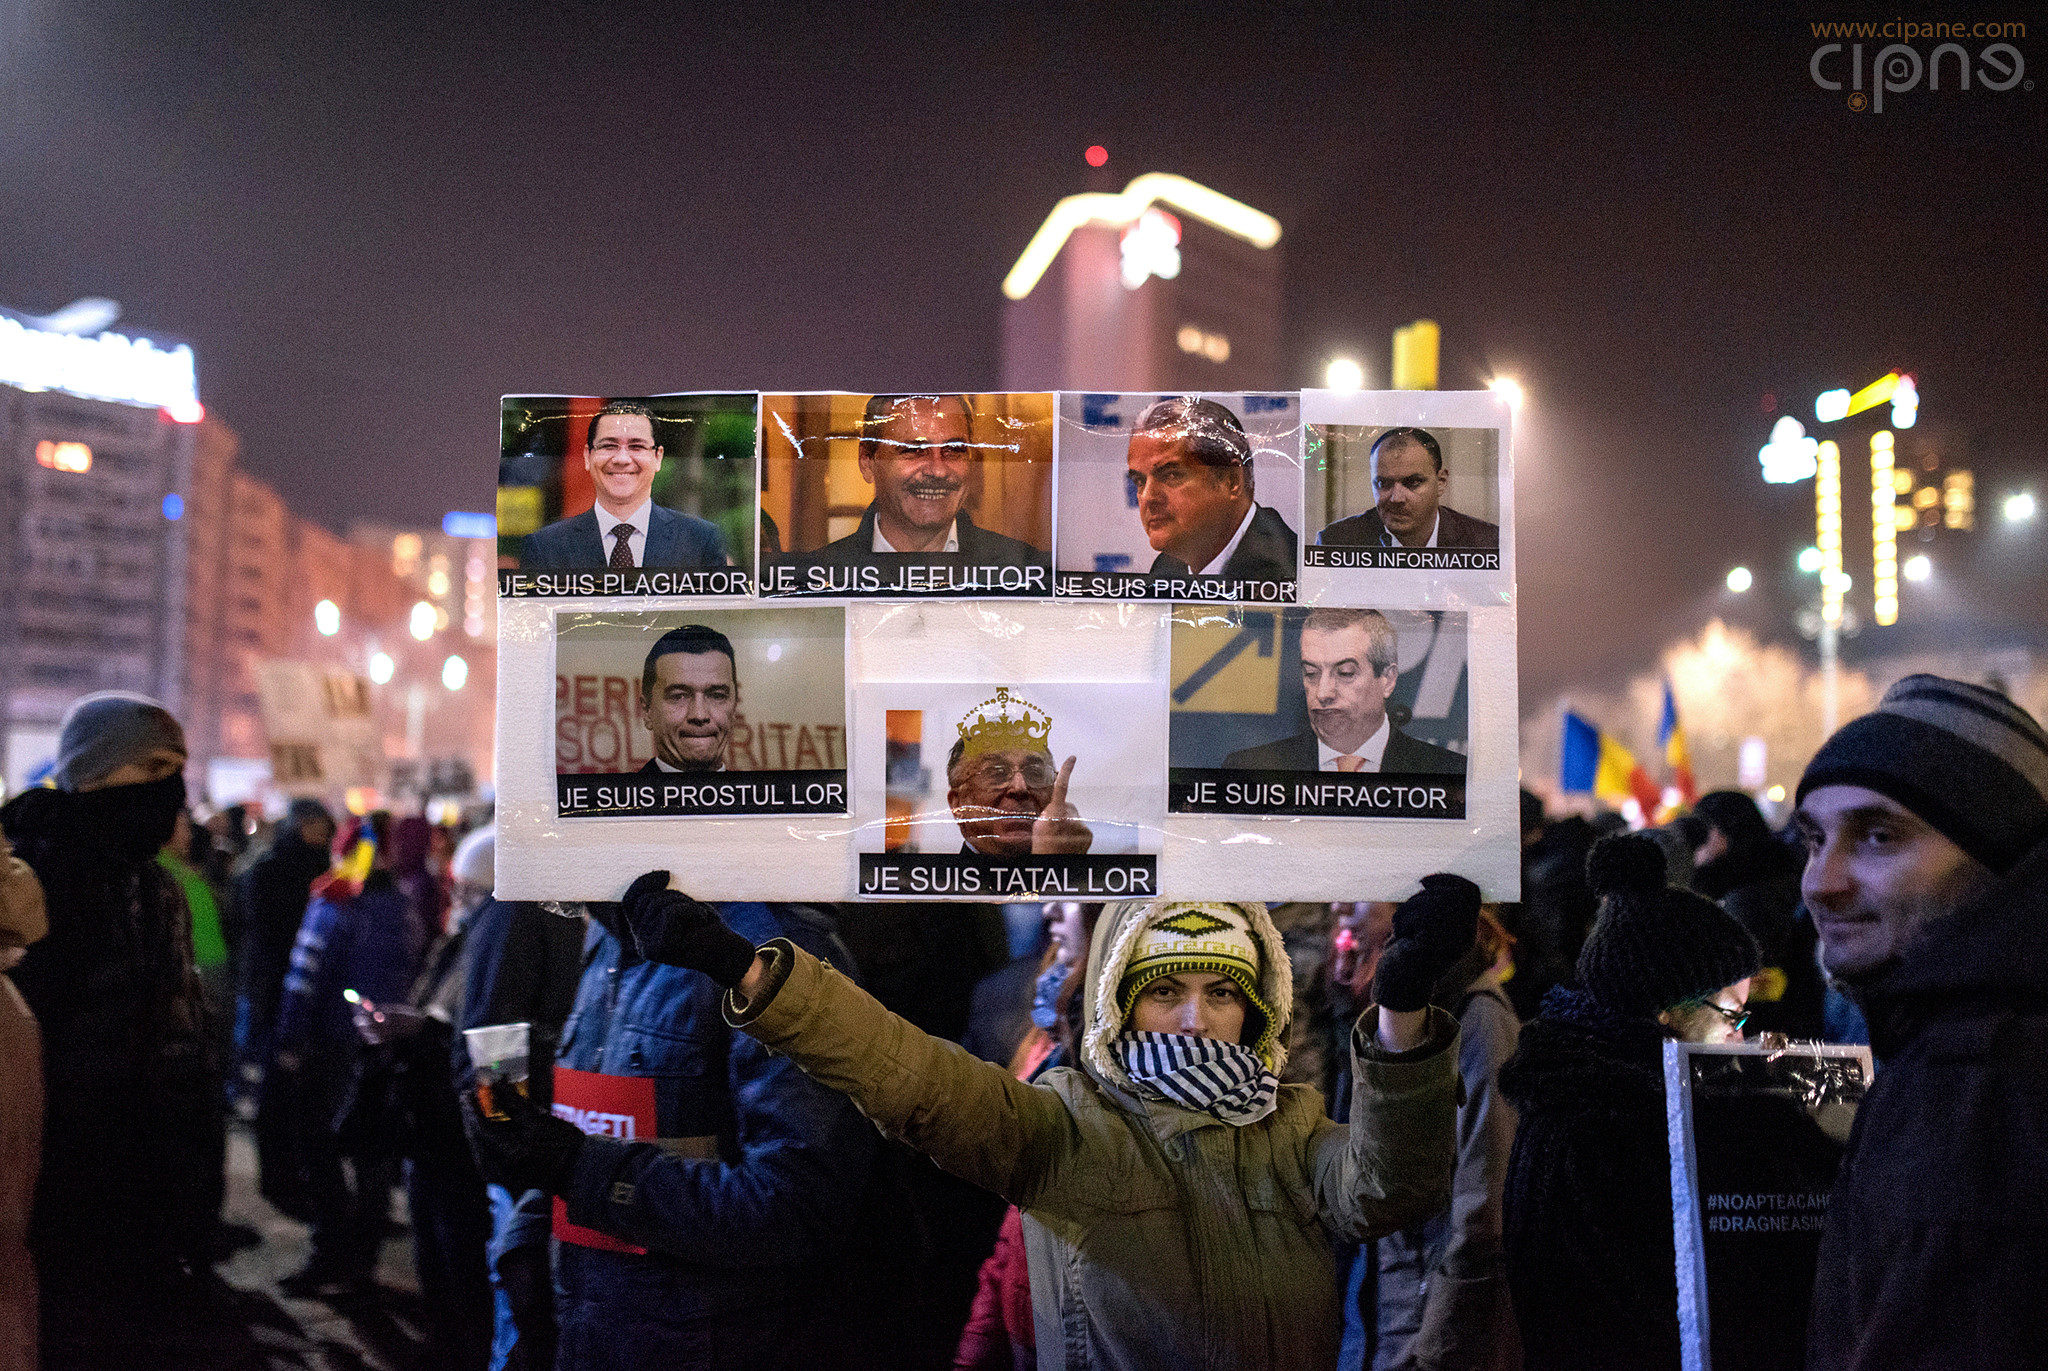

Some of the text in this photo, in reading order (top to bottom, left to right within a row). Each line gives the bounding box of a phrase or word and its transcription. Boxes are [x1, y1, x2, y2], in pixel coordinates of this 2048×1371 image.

[1304, 550, 1499, 569] JE SUIS INFORMATOR
[499, 572, 748, 596] JE SUIS PLAGIATOR
[760, 565, 1047, 592] JE SUIS JEFUITOR
[1055, 576, 1296, 601] JE SUIS PRADUITOR
[559, 783, 845, 809] JE SUIS PROSTUL LOR
[1186, 782, 1448, 809] JE SUIS INFRACTOR
[864, 866, 1151, 893] JE SUIS TATAL LOR
